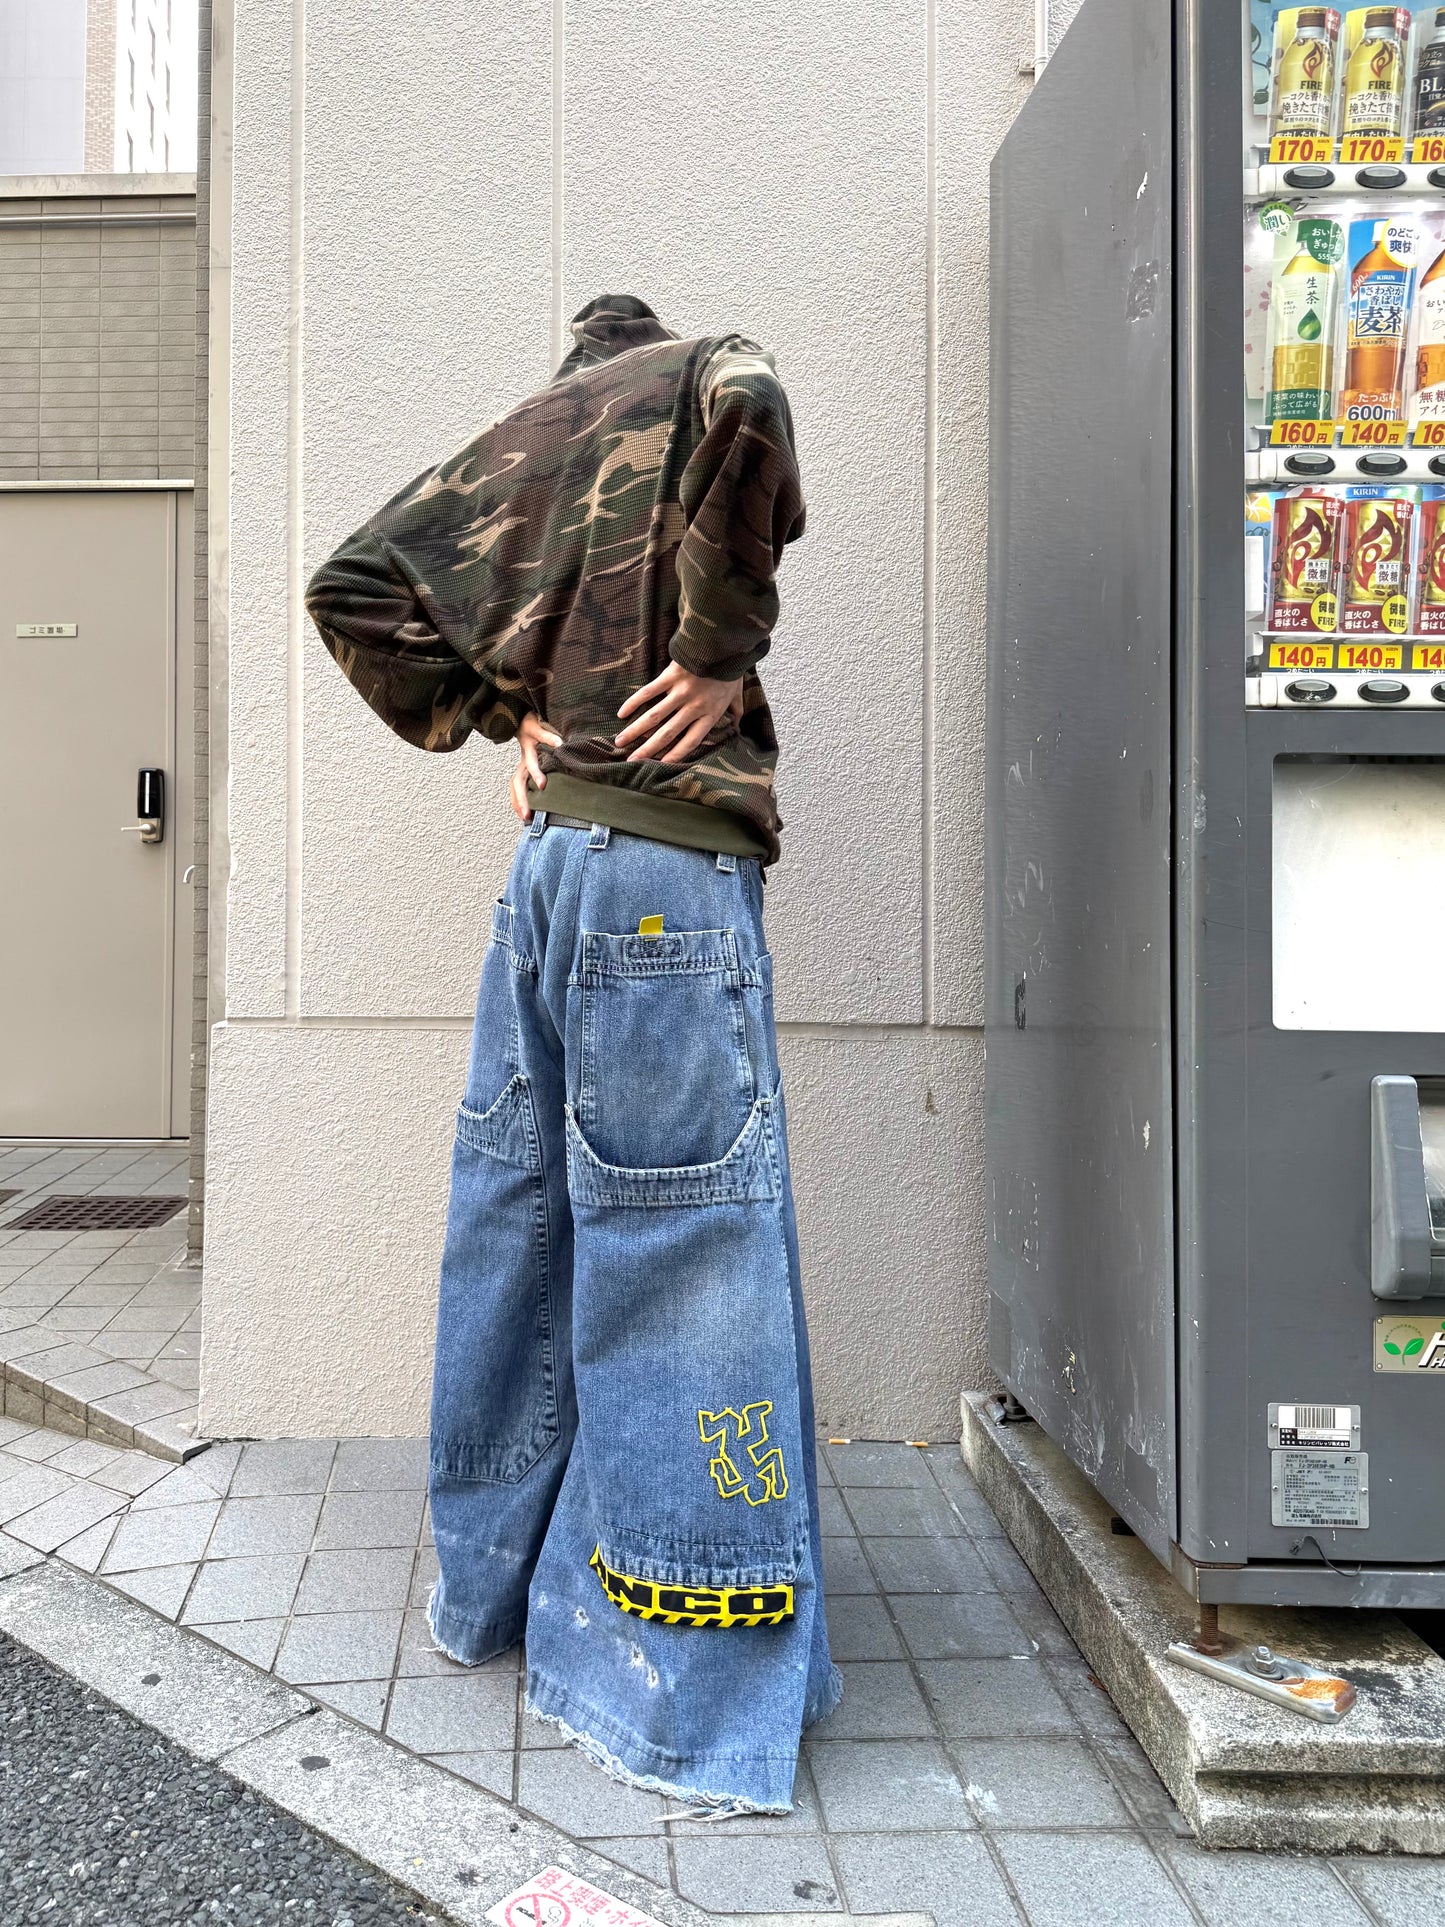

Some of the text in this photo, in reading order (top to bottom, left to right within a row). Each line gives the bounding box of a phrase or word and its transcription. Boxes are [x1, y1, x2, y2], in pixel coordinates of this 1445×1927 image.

[1300, 80, 1322, 90] FIRE
[1368, 80, 1391, 90] FIRE
[1420, 77, 1445, 94] BL
[1278, 140, 1326, 161] 170円
[1350, 139, 1397, 161] 170円
[1422, 140, 1445, 161] 16
[1264, 214, 1292, 231] 潤い
[1305, 276, 1320, 305] 生茶
[1365, 286, 1403, 297] さわやか
[1358, 306, 1402, 334] 麦茶
[1280, 422, 1328, 444] 160円
[1351, 423, 1399, 444] 140円
[1353, 488, 1378, 496] KIRIN
[1307, 568, 1327, 580] 微糖
[1379, 570, 1398, 582] 微糖
[1274, 608, 1300, 617] 直火の
[1345, 610, 1371, 620] 直火の
[1274, 617, 1308, 627] 香ばしさ
[1317, 616, 1334, 626] FIRE
[1344, 619, 1379, 630] 香ばしさ
[1388, 618, 1405, 628] FIRE
[1278, 646, 1326, 667] 140円
[1347, 647, 1395, 668] 140円
[1421, 648, 1445, 668] 14
